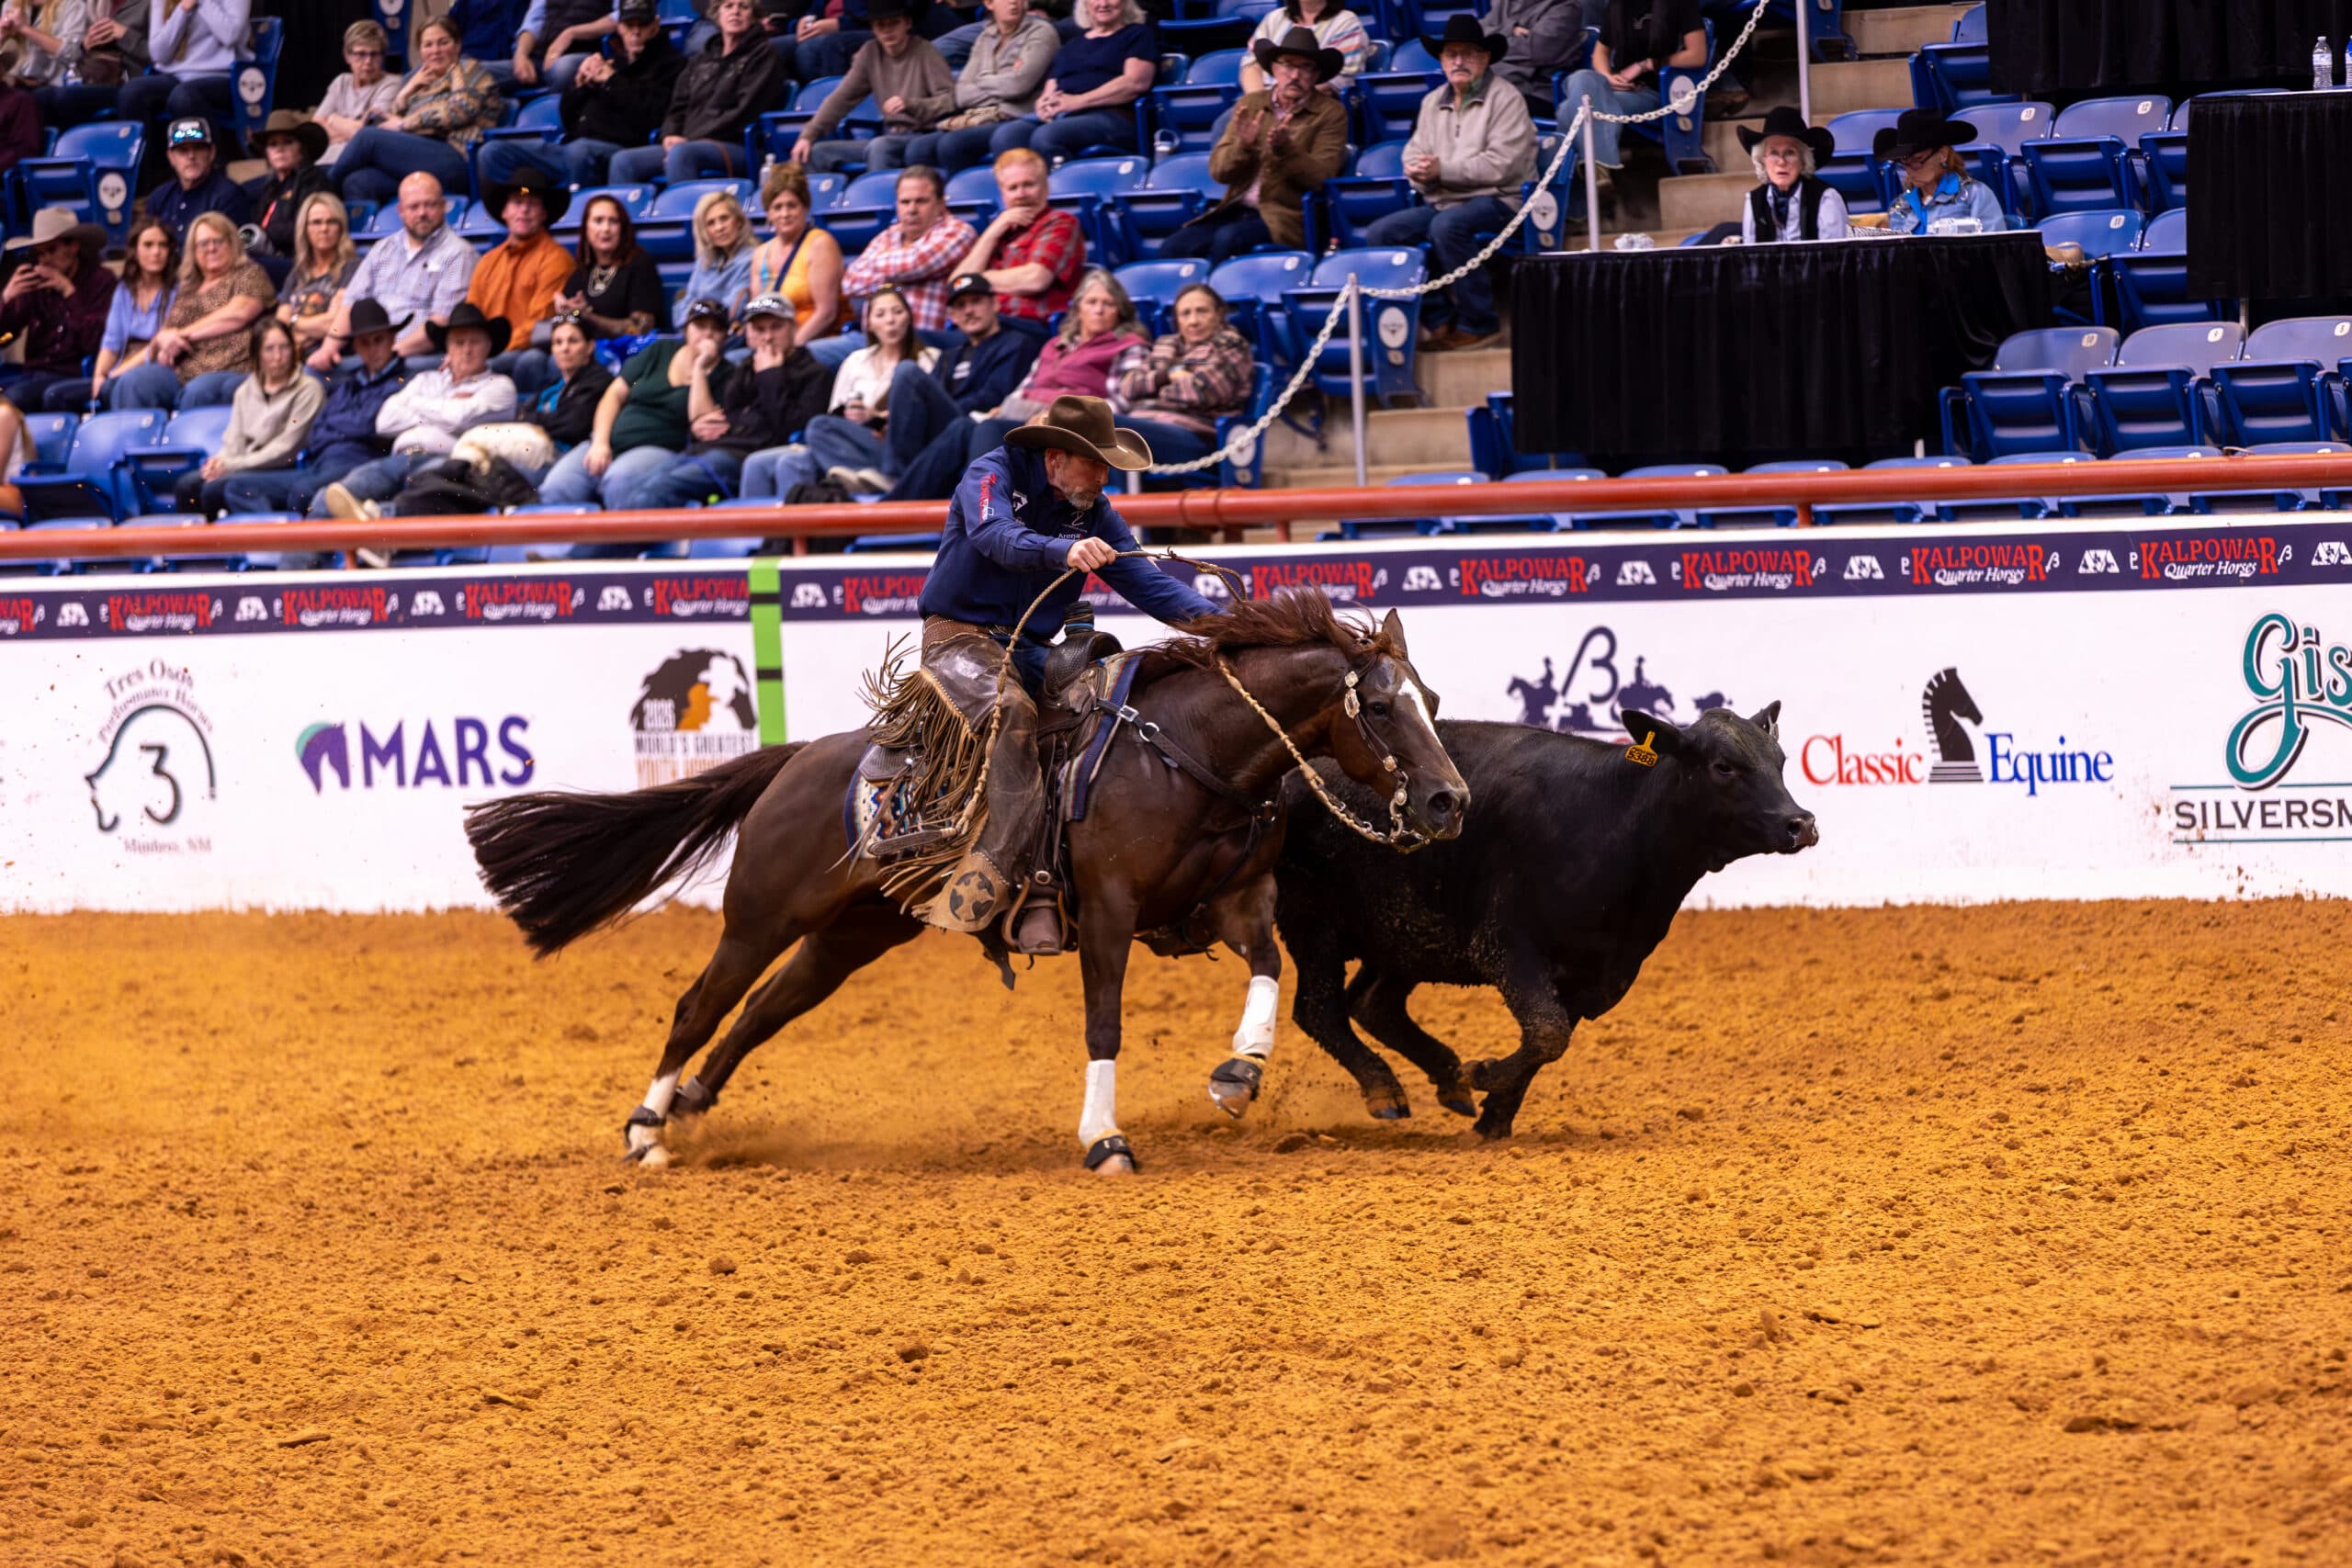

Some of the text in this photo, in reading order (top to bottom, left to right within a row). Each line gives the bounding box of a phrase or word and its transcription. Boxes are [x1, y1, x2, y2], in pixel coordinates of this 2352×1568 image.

[1459, 557, 1588, 595] KALPOWAR
[1681, 550, 1813, 589] KALPOWAR
[1911, 544, 2046, 584] KALPOWAR
[1935, 567, 2024, 585] Quarter Horses
[2140, 537, 2278, 579] KALPOWAR
[2165, 560, 2256, 580] Quarter Horses
[464, 581, 573, 618] KALPOWAR
[654, 579, 751, 615] KALPOWA
[1251, 561, 1375, 600] KALPOWAR
[1704, 573, 1753, 590] Quarter
[108, 592, 212, 630] KALPOWAR
[283, 588, 389, 625] KALPOWAR
[360, 715, 535, 787] MARS
[1801, 732, 2113, 797] Classic Equine
